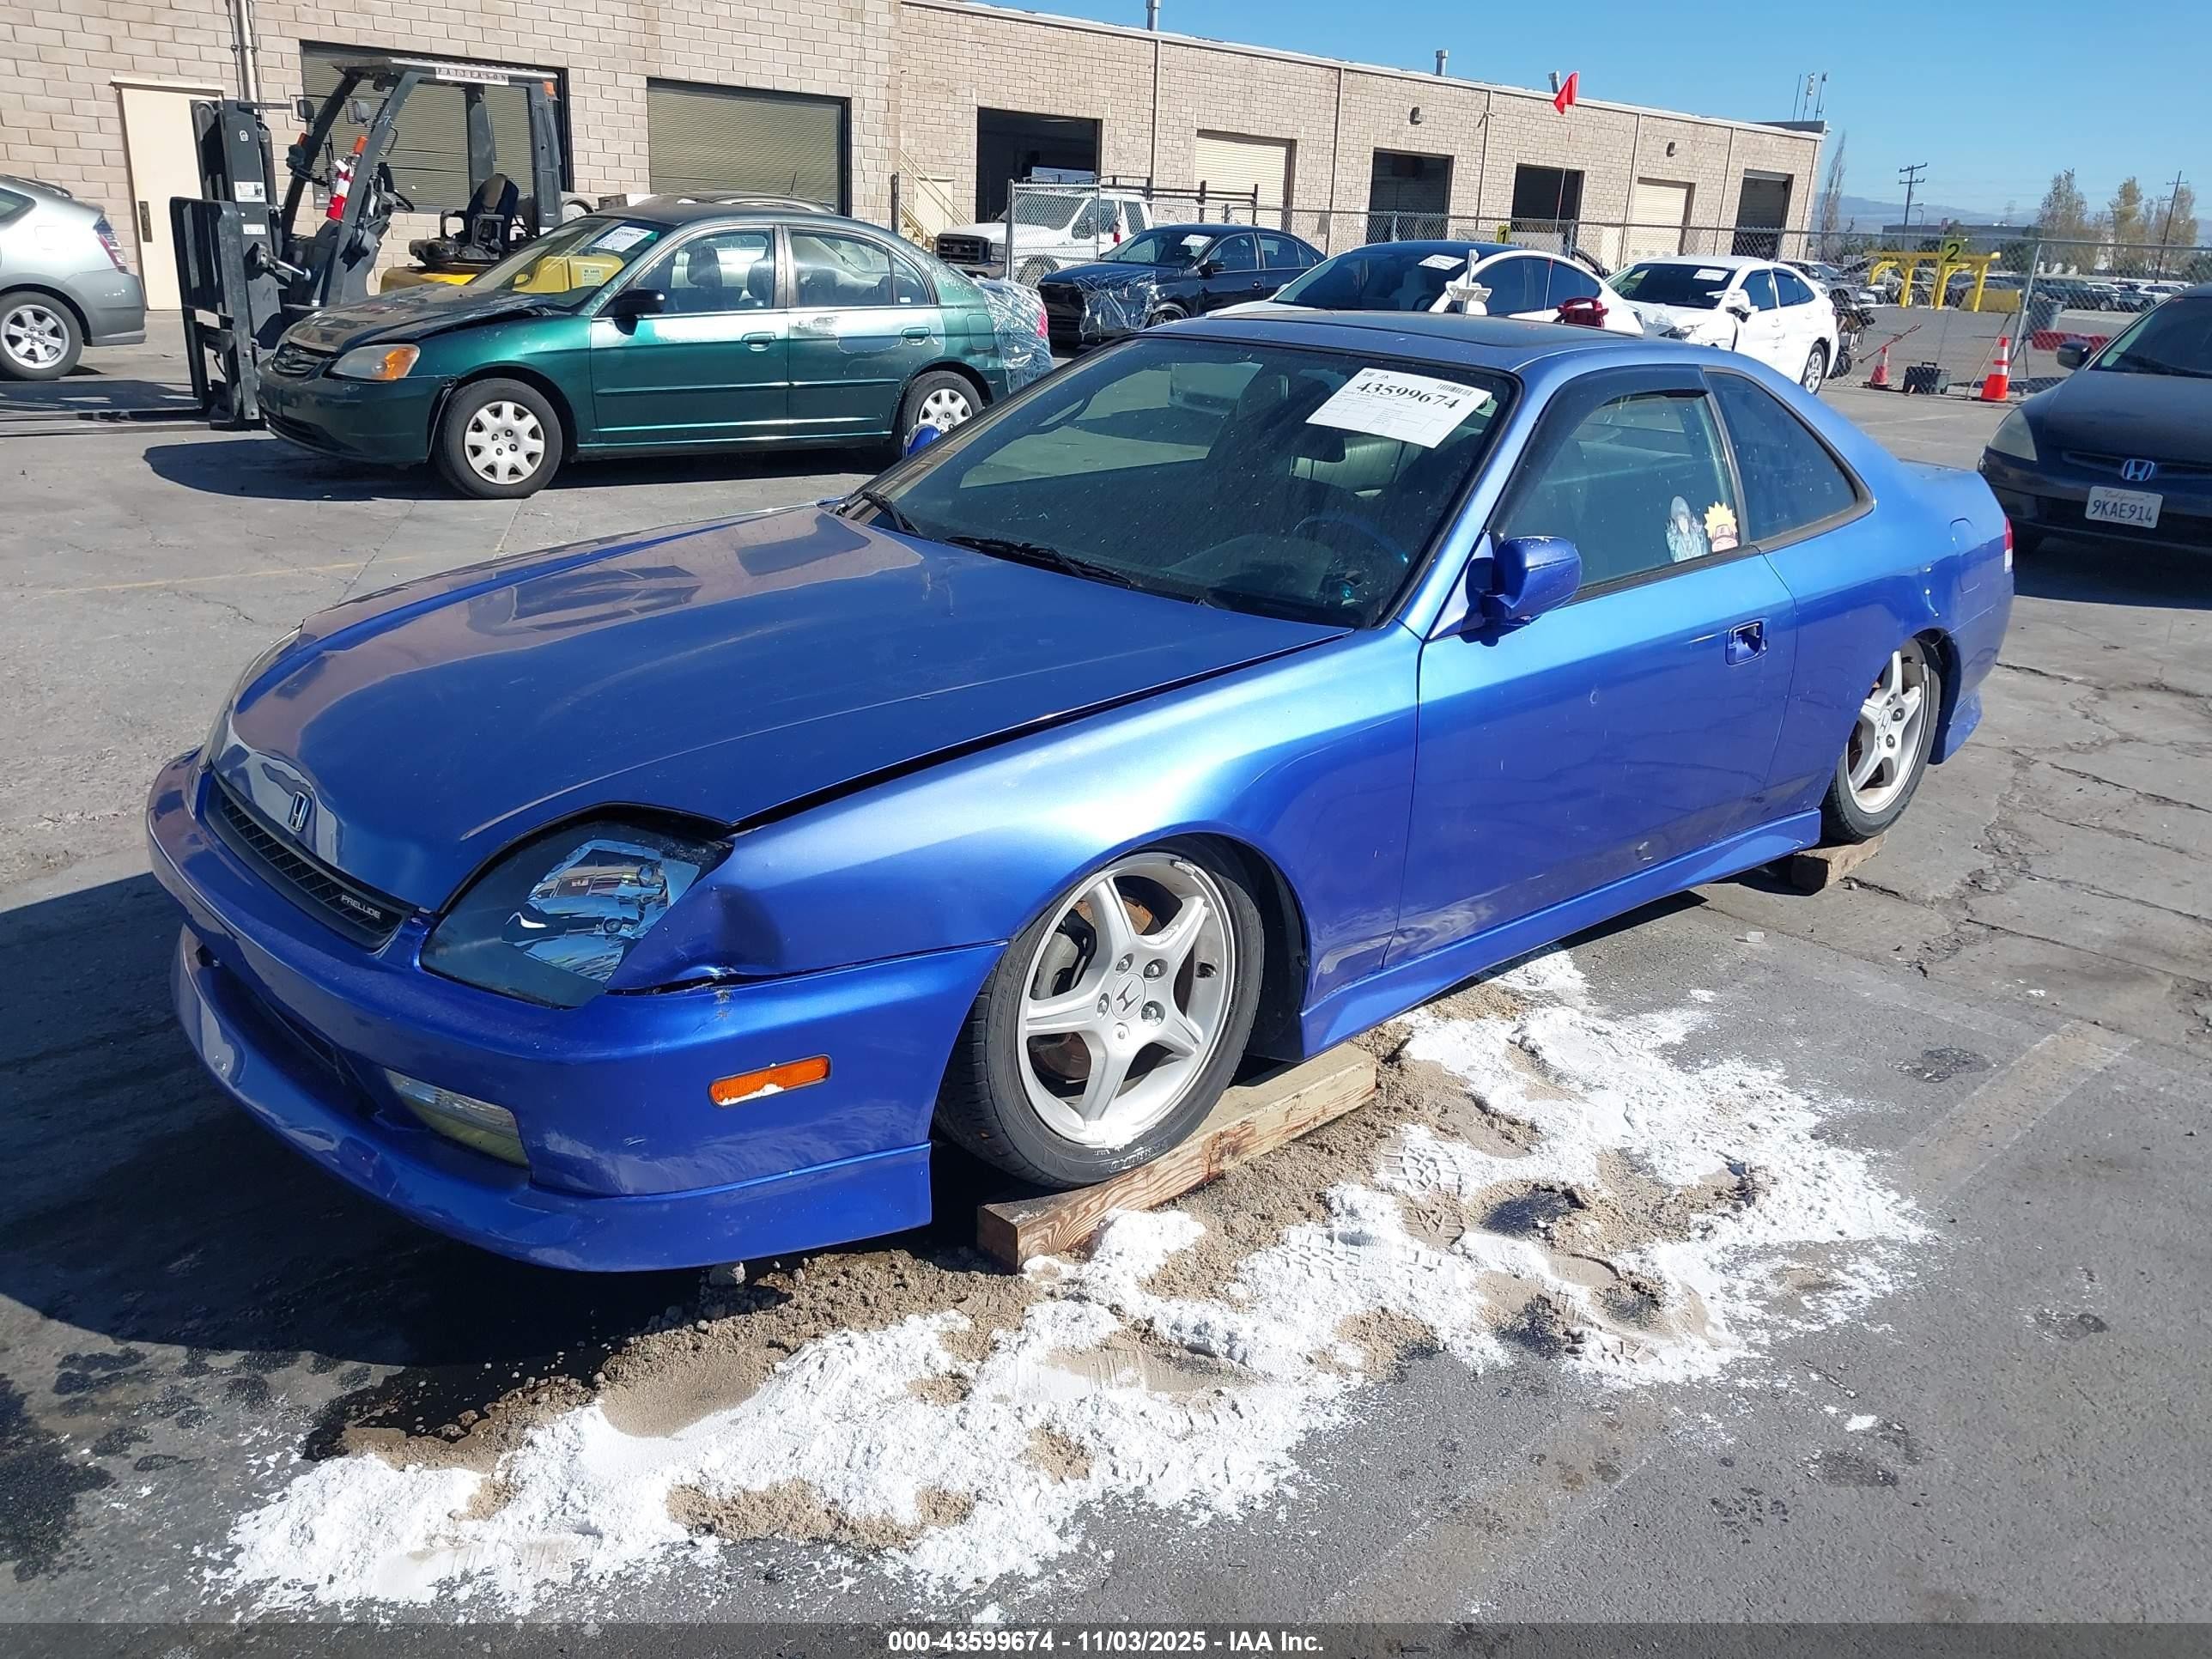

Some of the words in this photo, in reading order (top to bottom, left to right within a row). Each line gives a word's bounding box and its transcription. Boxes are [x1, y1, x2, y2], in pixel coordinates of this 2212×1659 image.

[438, 68, 506, 81] PATTERSON
[1944, 243, 1960, 263] 2
[1357, 382, 1460, 409] 43599674
[2092, 500, 2152, 522] 9KAE914
[341, 895, 380, 919] PRELUDE
